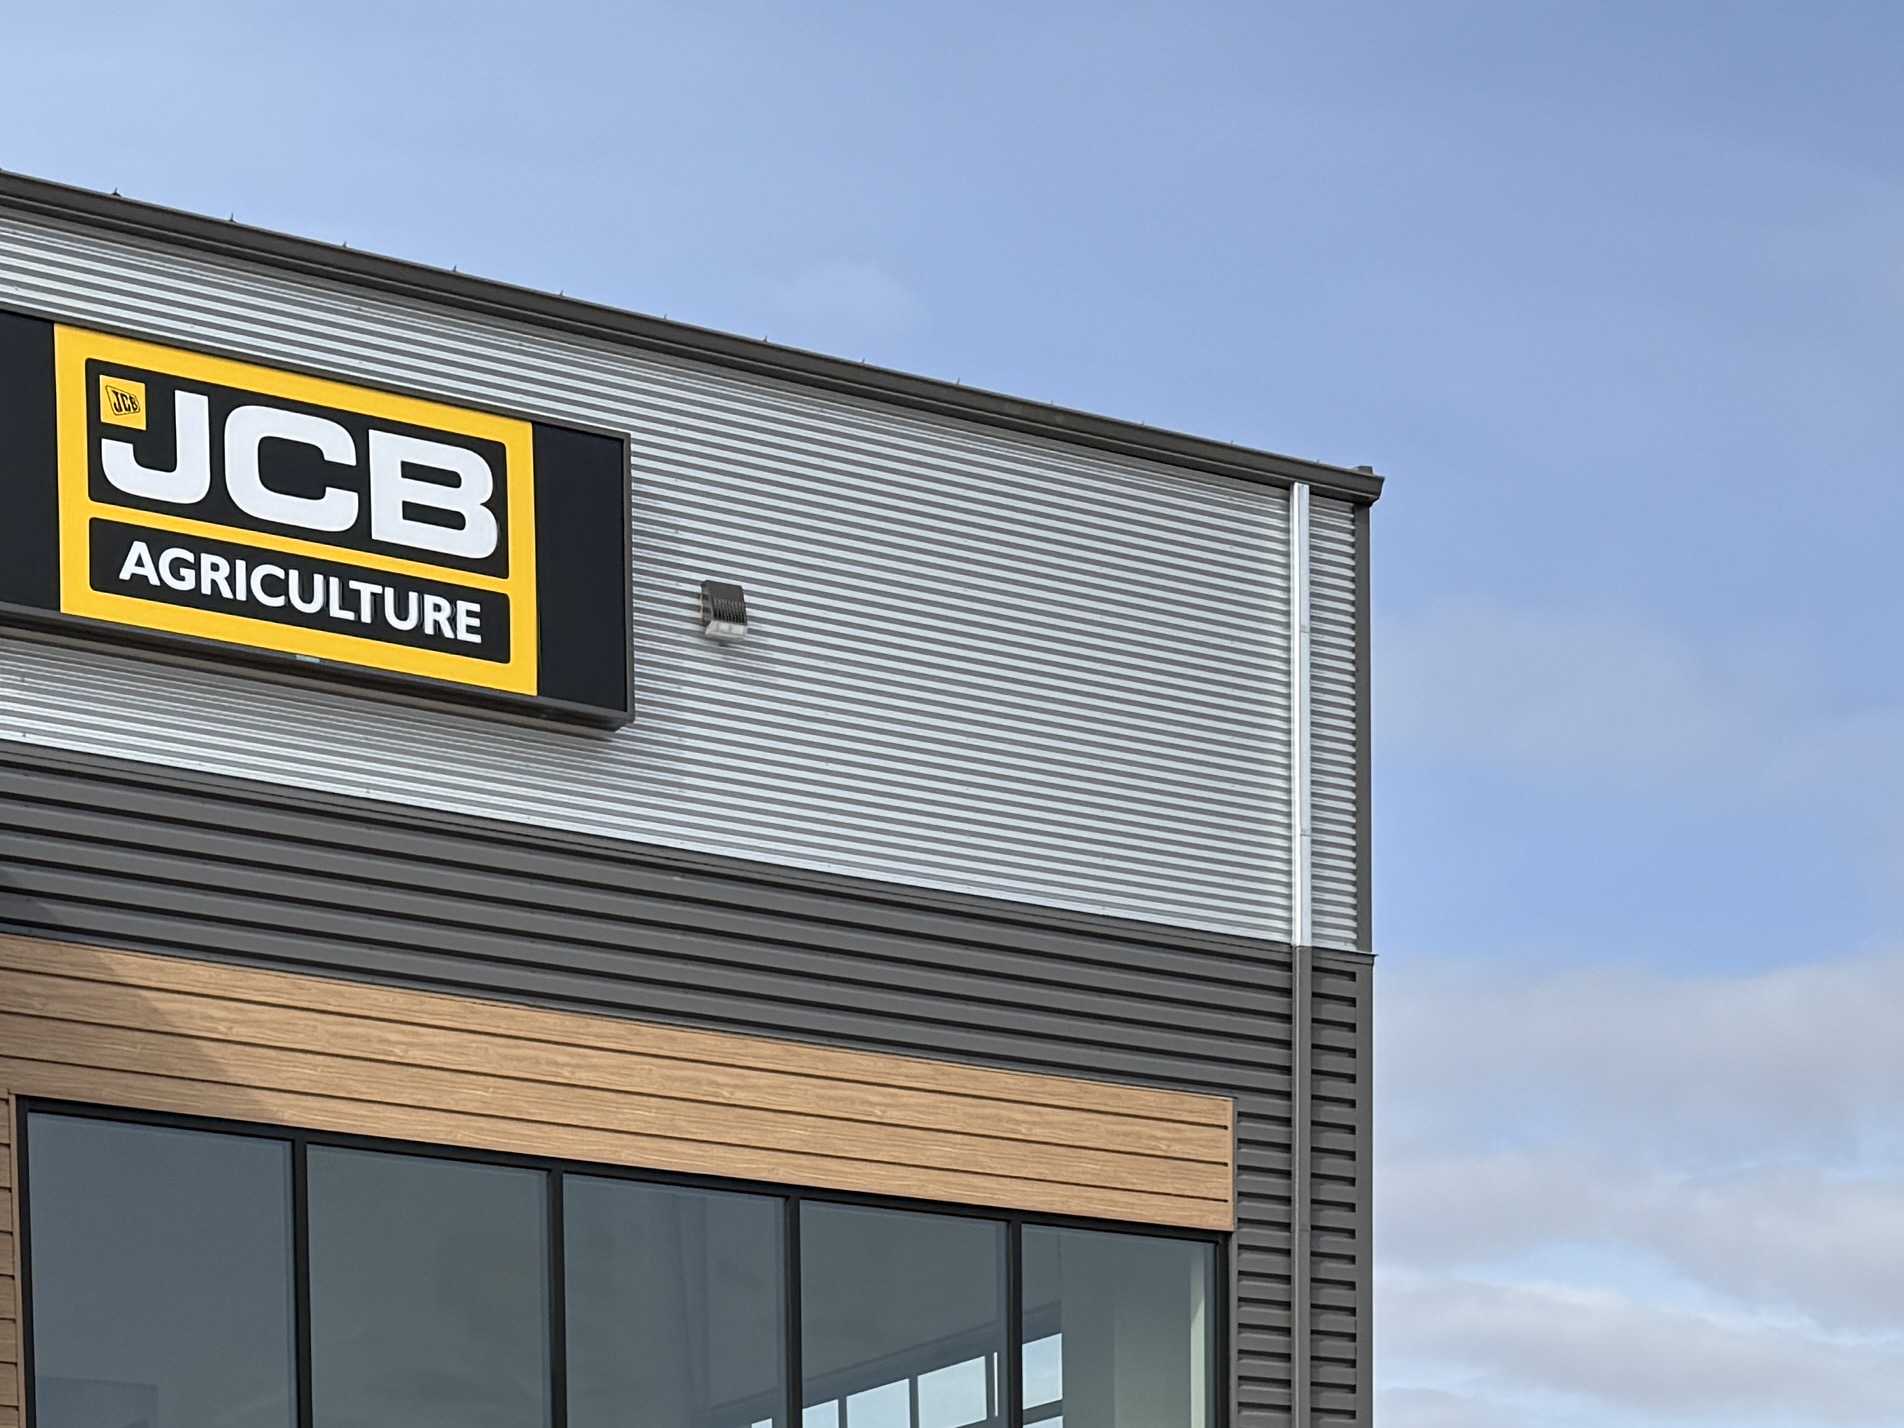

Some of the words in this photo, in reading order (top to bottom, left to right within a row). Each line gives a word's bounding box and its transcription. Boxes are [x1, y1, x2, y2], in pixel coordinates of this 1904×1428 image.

[111, 389, 139, 413] JCB
[100, 389, 499, 560] JCB
[118, 540, 483, 645] AGRICULTURE
